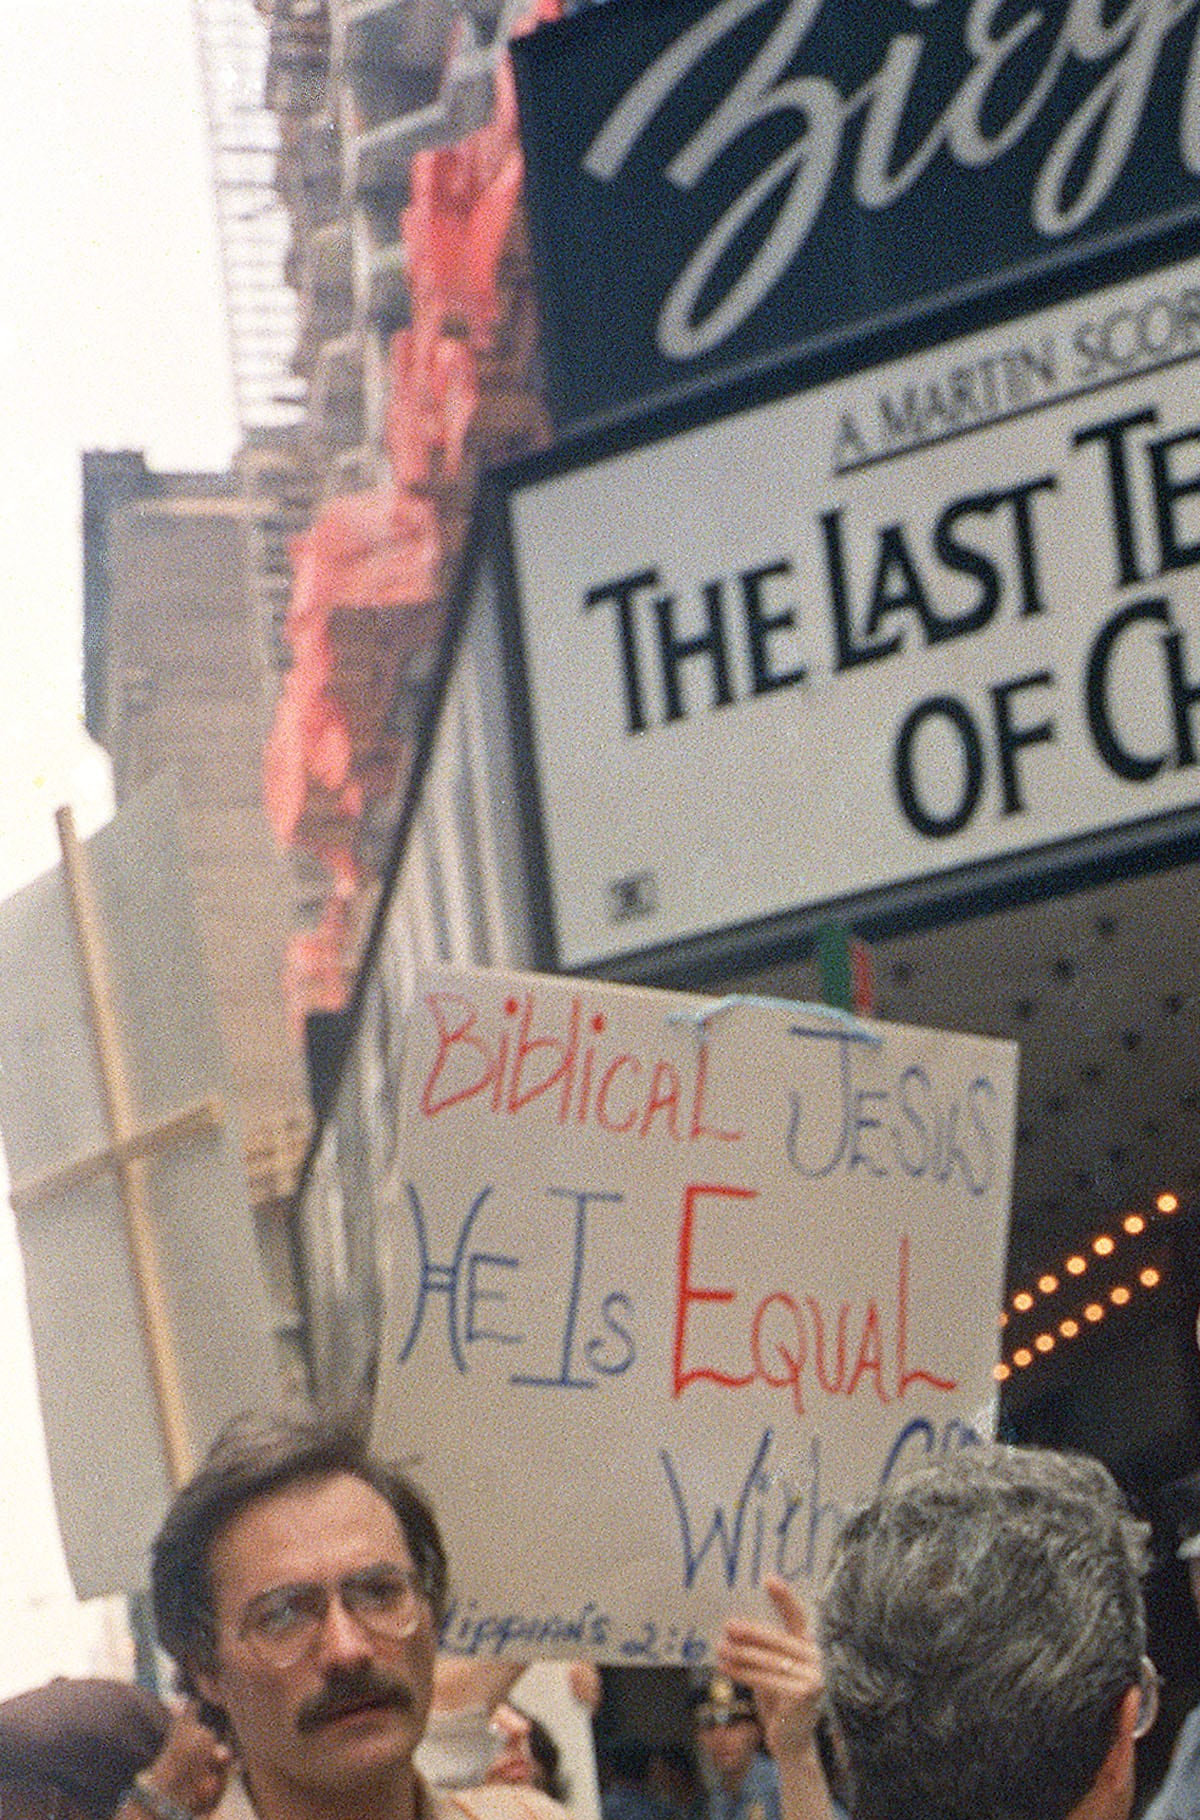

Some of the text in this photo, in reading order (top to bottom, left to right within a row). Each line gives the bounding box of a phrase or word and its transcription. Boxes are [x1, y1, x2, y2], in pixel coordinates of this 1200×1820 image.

[833, 410, 867, 465] A
[877, 334, 1058, 440] MARTIN
[584, 565, 808, 736] THE
[818, 474, 1058, 674] LAST
[891, 670, 1057, 840] OF
